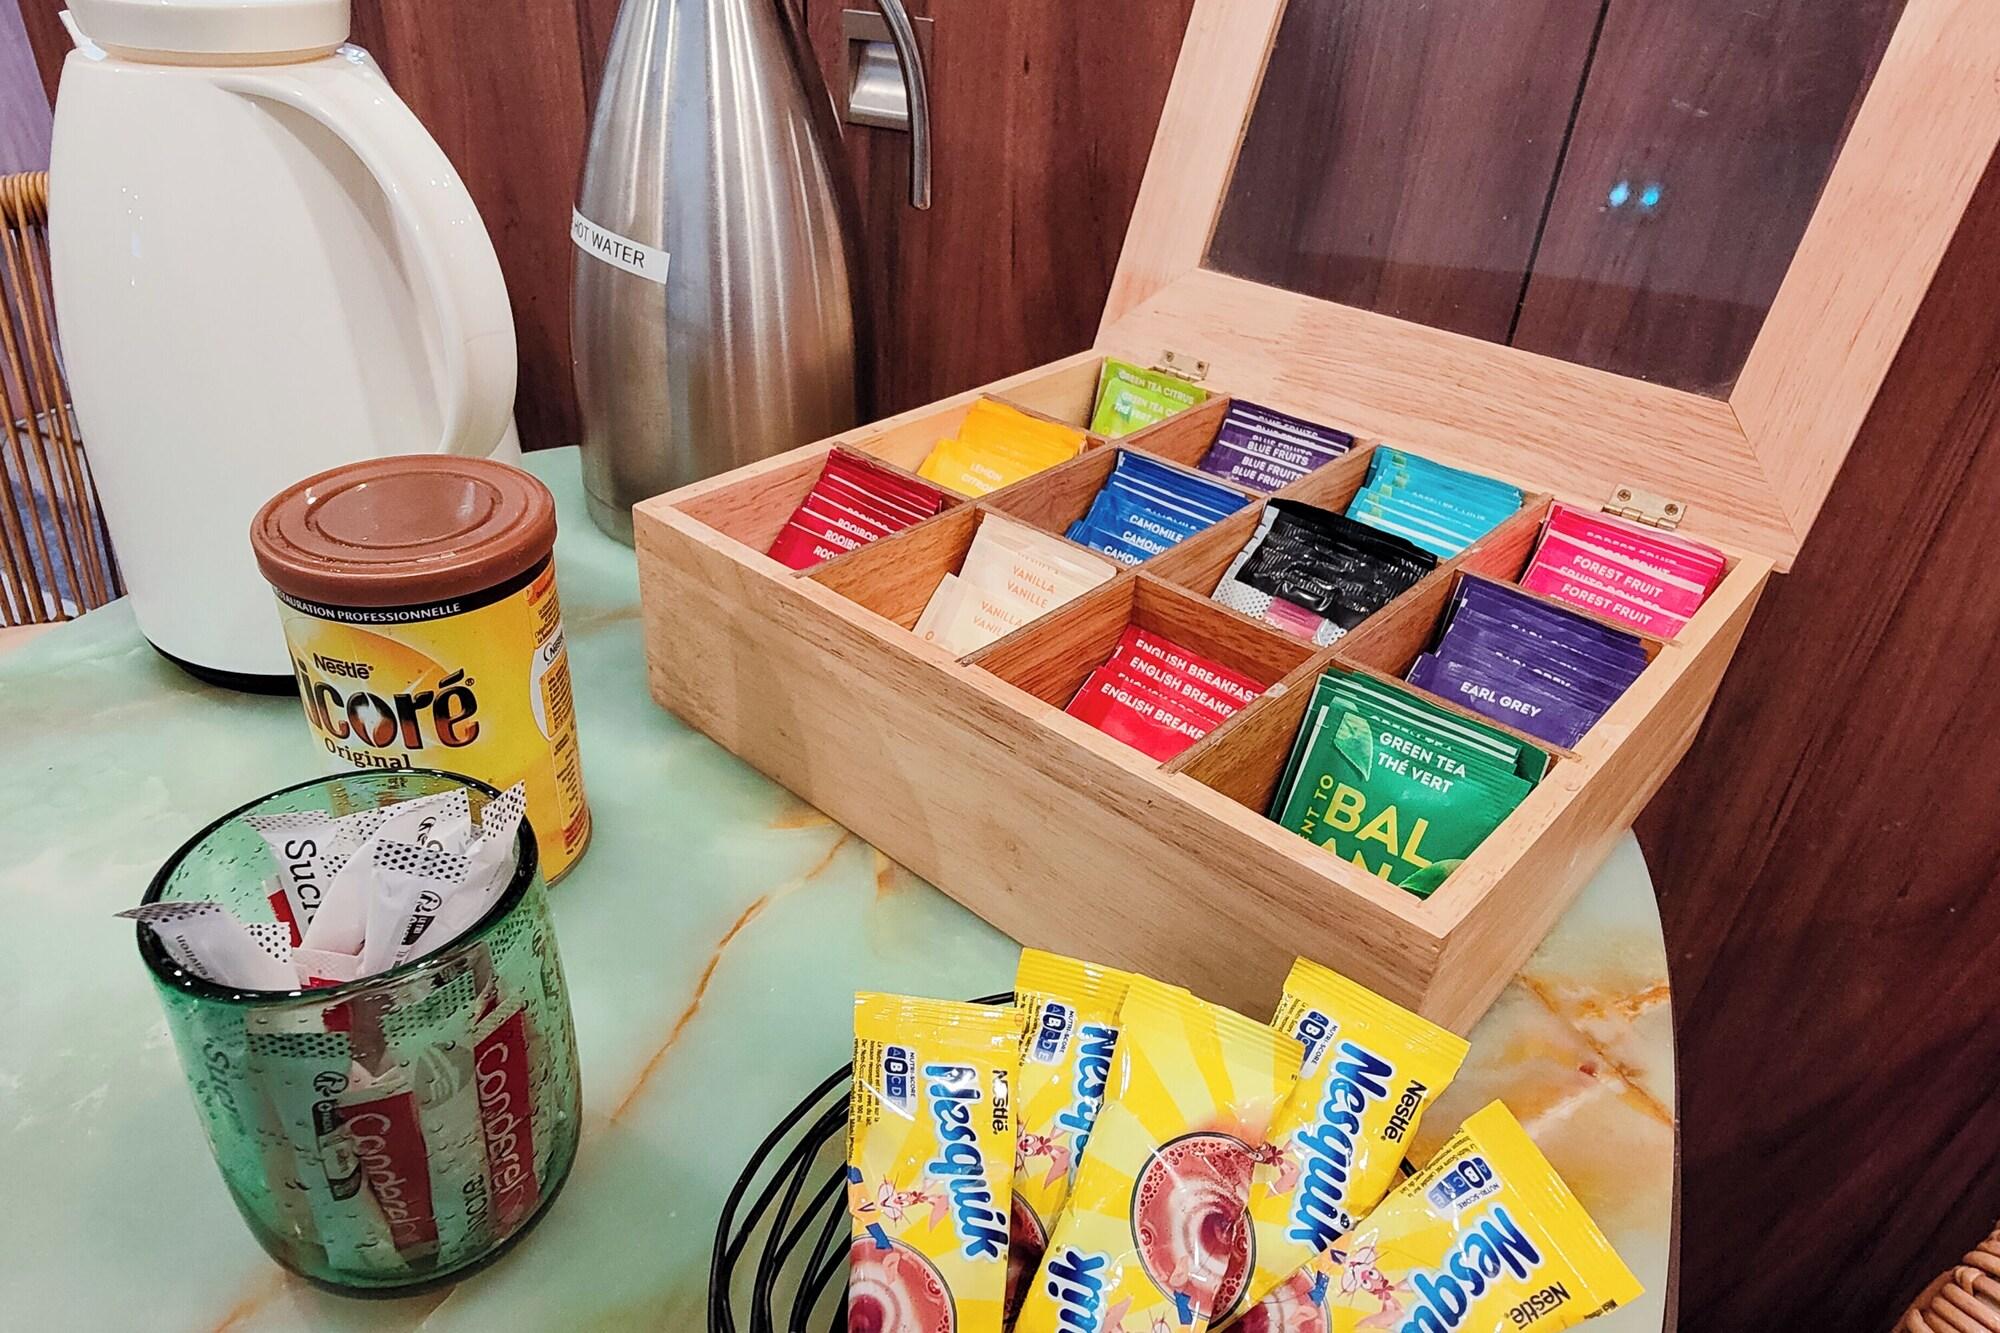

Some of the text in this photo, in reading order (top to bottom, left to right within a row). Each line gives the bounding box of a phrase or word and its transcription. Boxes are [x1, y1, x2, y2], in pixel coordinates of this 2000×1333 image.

[591, 230, 645, 269] WATER
[1119, 370, 1194, 405] GREEN TEA CITRUS
[1241, 456, 1304, 481] BLUE FRUITS
[1247, 440, 1310, 467] BLUE FRUITS
[970, 463, 1004, 482] LEMON
[1231, 465, 1258, 482] BLUE
[1129, 514, 1184, 544] CAMOMILE
[1013, 565, 1057, 595] VANILLA
[1572, 555, 1664, 598] FOREST FRUIT
[337, 602, 461, 622] PROFESSIONNELLE
[1006, 580, 1049, 609] VANILLE
[1561, 583, 1613, 609] FOREST
[1612, 602, 1653, 625] FRUIT
[981, 601, 1024, 627] VANILLA
[1136, 638, 1188, 670] ENGLISH
[1129, 656, 1184, 691] ENGLISH
[1100, 682, 1155, 717] ENGLISH
[1460, 681, 1542, 718] EARL GREY
[324, 736, 412, 770] Original
[1379, 732, 1434, 764] GREEN
[1436, 755, 1466, 778] TEA
[1314, 774, 1335, 801] TO
[1378, 752, 1454, 793] THÉ VERT
[1323, 782, 1433, 870] BAL
[1060, 1010, 1075, 1054] NUTRI-SCORE
[1311, 1024, 1338, 1065] NUTRI-SCORE
[909, 1051, 917, 1098] NUTRI-SCORE
[475, 1041, 530, 1195] Canderel
[1384, 1079, 1428, 1143] Nestlé
[925, 1065, 1010, 1259] Nesquik
[1289, 1042, 1393, 1253] Nesquik
[1457, 1183, 1500, 1210] NUTRI-SCORE
[1511, 1280, 1572, 1331] Nestlé
